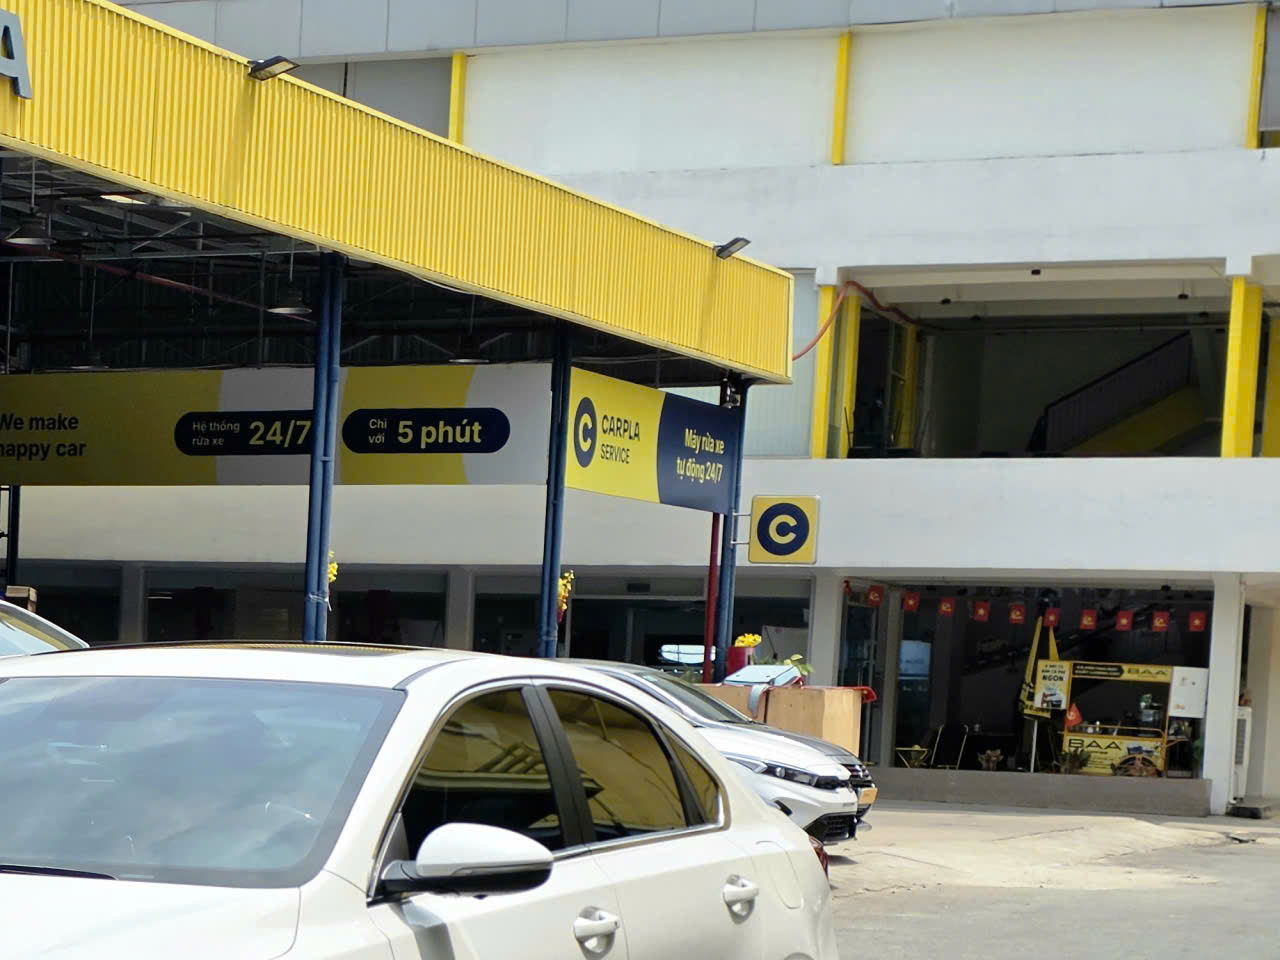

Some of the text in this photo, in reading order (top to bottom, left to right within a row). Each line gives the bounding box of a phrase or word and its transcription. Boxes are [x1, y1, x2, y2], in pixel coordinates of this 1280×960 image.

[29, 413, 80, 431] make
[248, 419, 312, 448] 24/7
[397, 420, 414, 444] 5
[420, 418, 483, 449] phút
[601, 413, 641, 442] CARPLA
[55, 442, 87, 457] car
[211, 437, 225, 446] xe
[684, 428, 702, 454] Máy
[715, 439, 725, 455] xe
[600, 443, 631, 465] SERVICE
[676, 456, 724, 484] tự động 24/7
[1068, 738, 1122, 751] BAA
